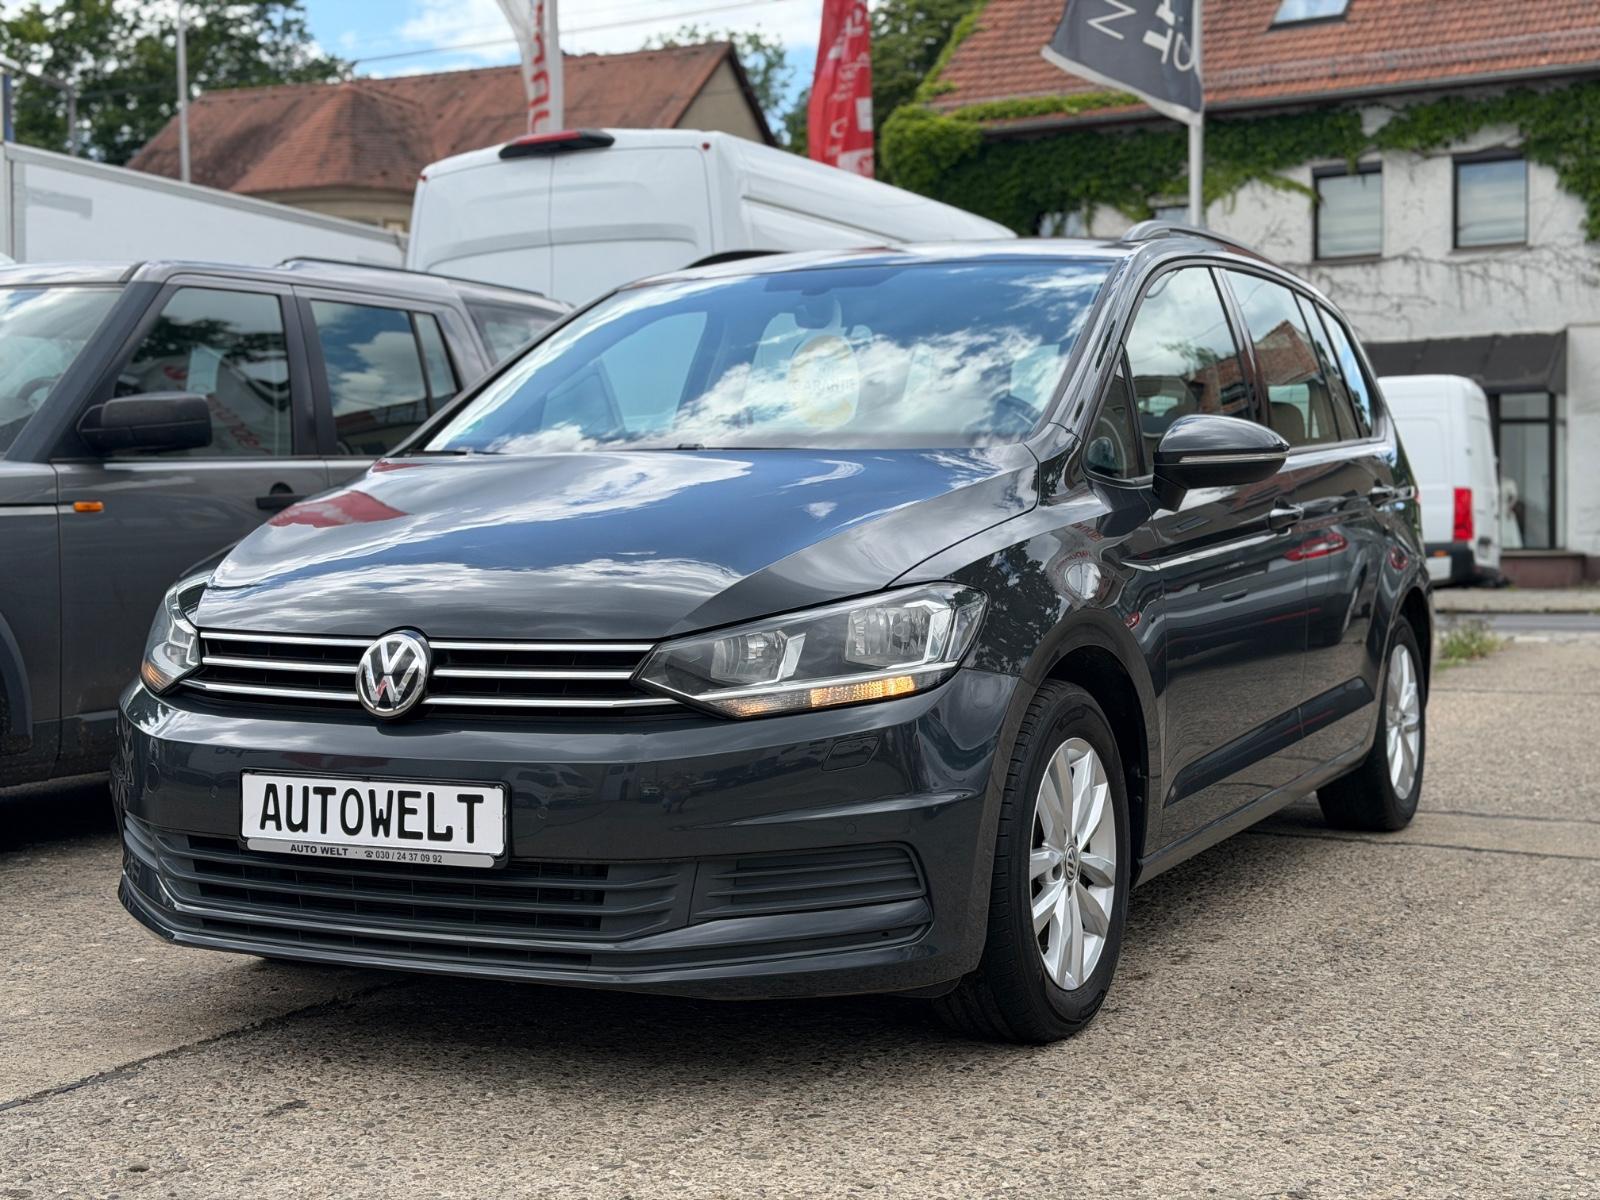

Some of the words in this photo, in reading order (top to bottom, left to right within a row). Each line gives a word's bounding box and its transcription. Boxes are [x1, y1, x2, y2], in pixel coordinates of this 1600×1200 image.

[359, 635, 424, 714] VW
[259, 783, 484, 844] AUTOWELT
[290, 844, 317, 854] AUTO
[320, 846, 349, 856] WELT
[375, 850, 390, 860] 030
[396, 851, 406, 861] 24
[408, 852, 418, 861] 37
[420, 853, 430, 862] 09
[432, 854, 443, 863] 92
